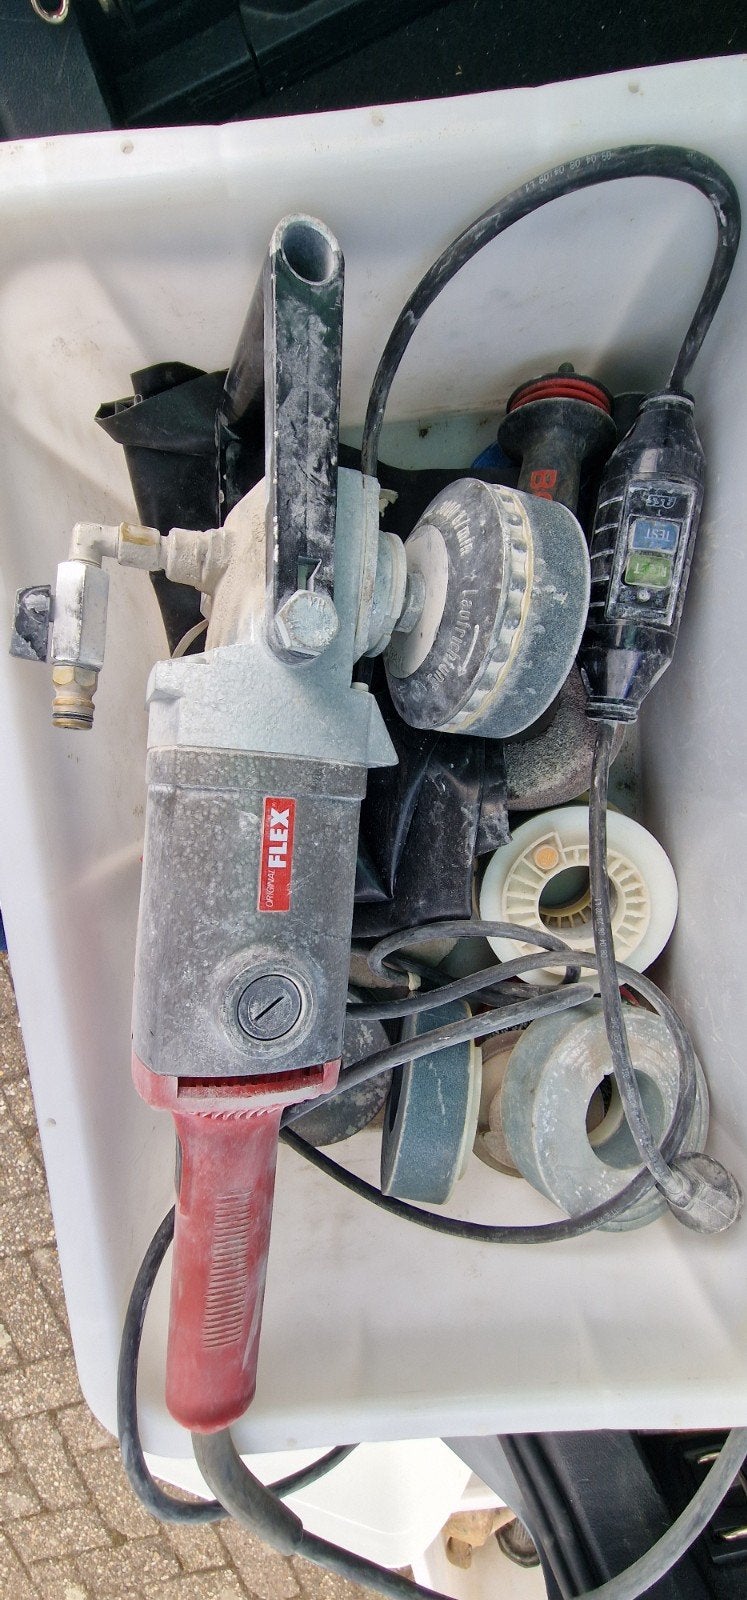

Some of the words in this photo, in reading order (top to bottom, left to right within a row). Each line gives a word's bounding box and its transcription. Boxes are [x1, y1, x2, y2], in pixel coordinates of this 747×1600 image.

[645, 528, 670, 542] TEST
[426, 589, 479, 692] Laufrichtung
[268, 807, 290, 868] FLEX
[265, 869, 276, 908] ORIGINAL
